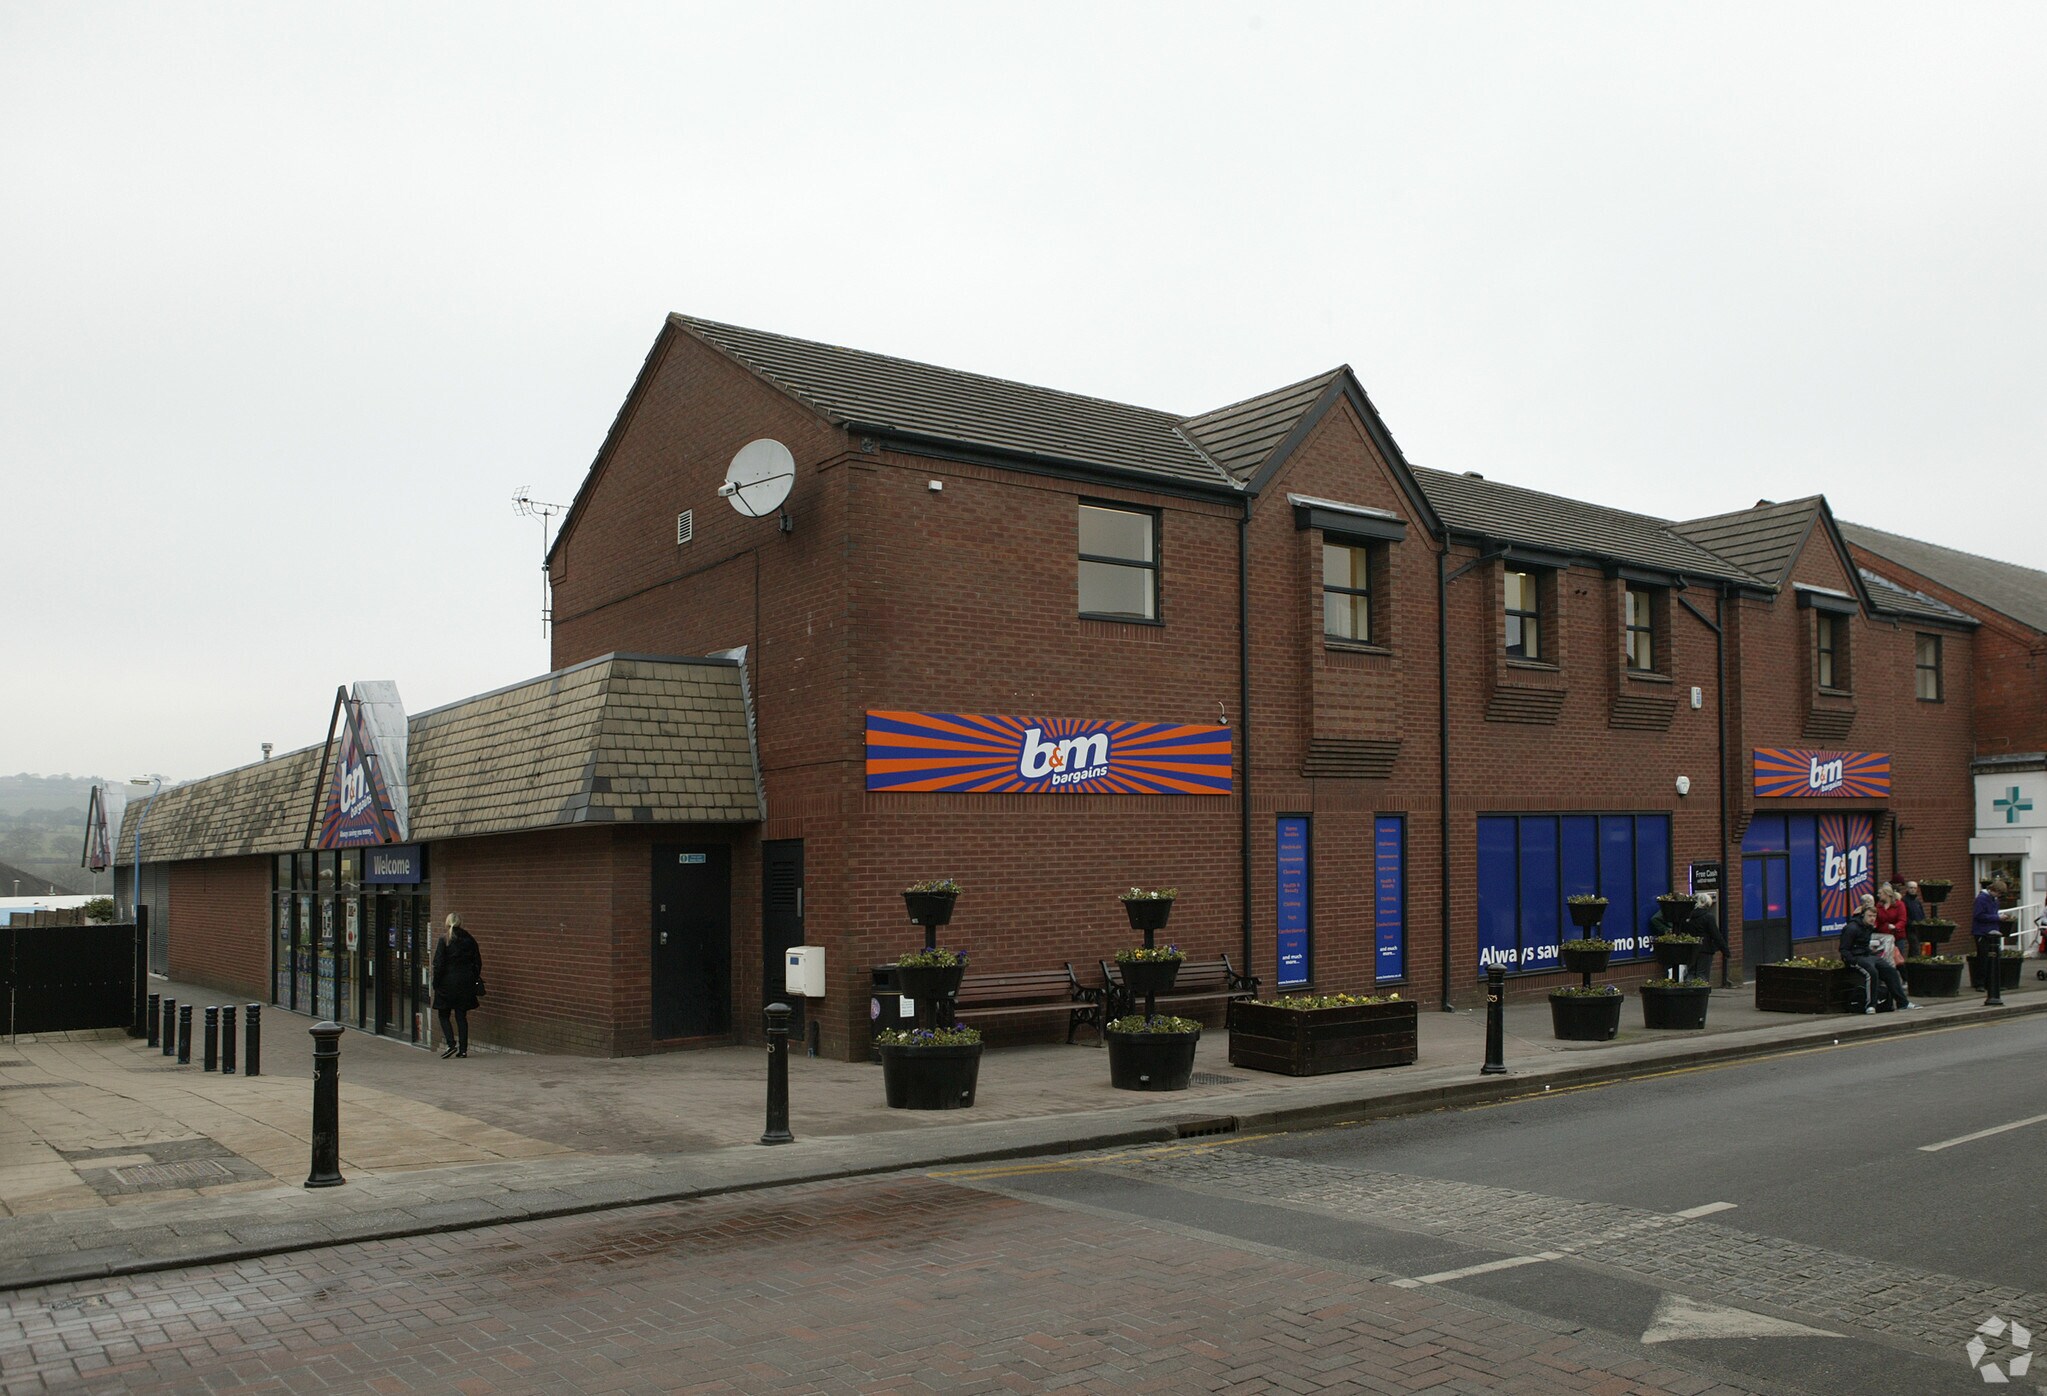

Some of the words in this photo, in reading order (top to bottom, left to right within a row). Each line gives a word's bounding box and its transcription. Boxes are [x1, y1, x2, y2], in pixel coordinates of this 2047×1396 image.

[1021, 728, 1109, 778] b&m
[1052, 766, 1108, 785] bargains
[1810, 757, 1843, 788] b&m
[374, 854, 410, 876] Welcome
[1696, 870, 1706, 878] Free
[1840, 872, 1868, 891] bagains
